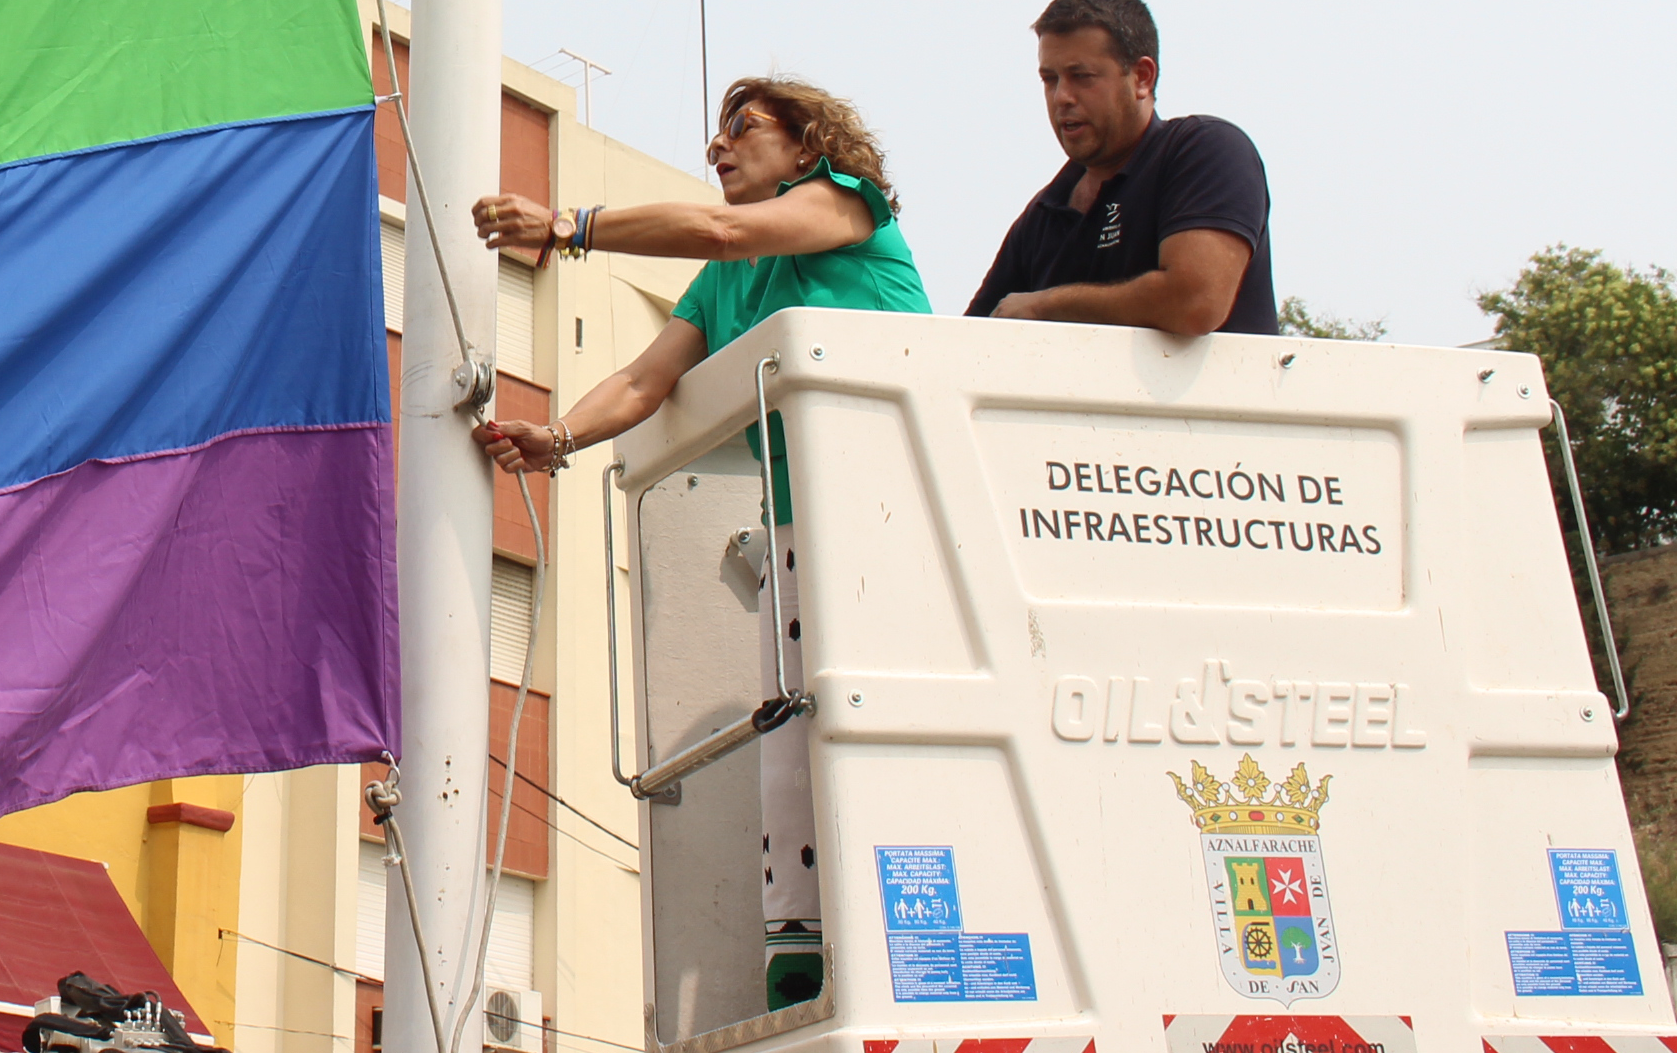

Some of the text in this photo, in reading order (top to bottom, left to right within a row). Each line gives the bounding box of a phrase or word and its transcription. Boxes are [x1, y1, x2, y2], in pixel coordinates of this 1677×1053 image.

[1046, 461, 1344, 506] DELEGACIÓN DE
[1019, 508, 1382, 555] INFRAESTRUCTURAS
[1207, 838, 1317, 853] AZNALFARACHE
[900, 885, 937, 896] 200 Kg.
[1310, 875, 1324, 898] DE
[1573, 885, 1605, 896] 200 Kg.
[1213, 880, 1234, 954] VILLA
[1248, 980, 1320, 994] DE SAN
